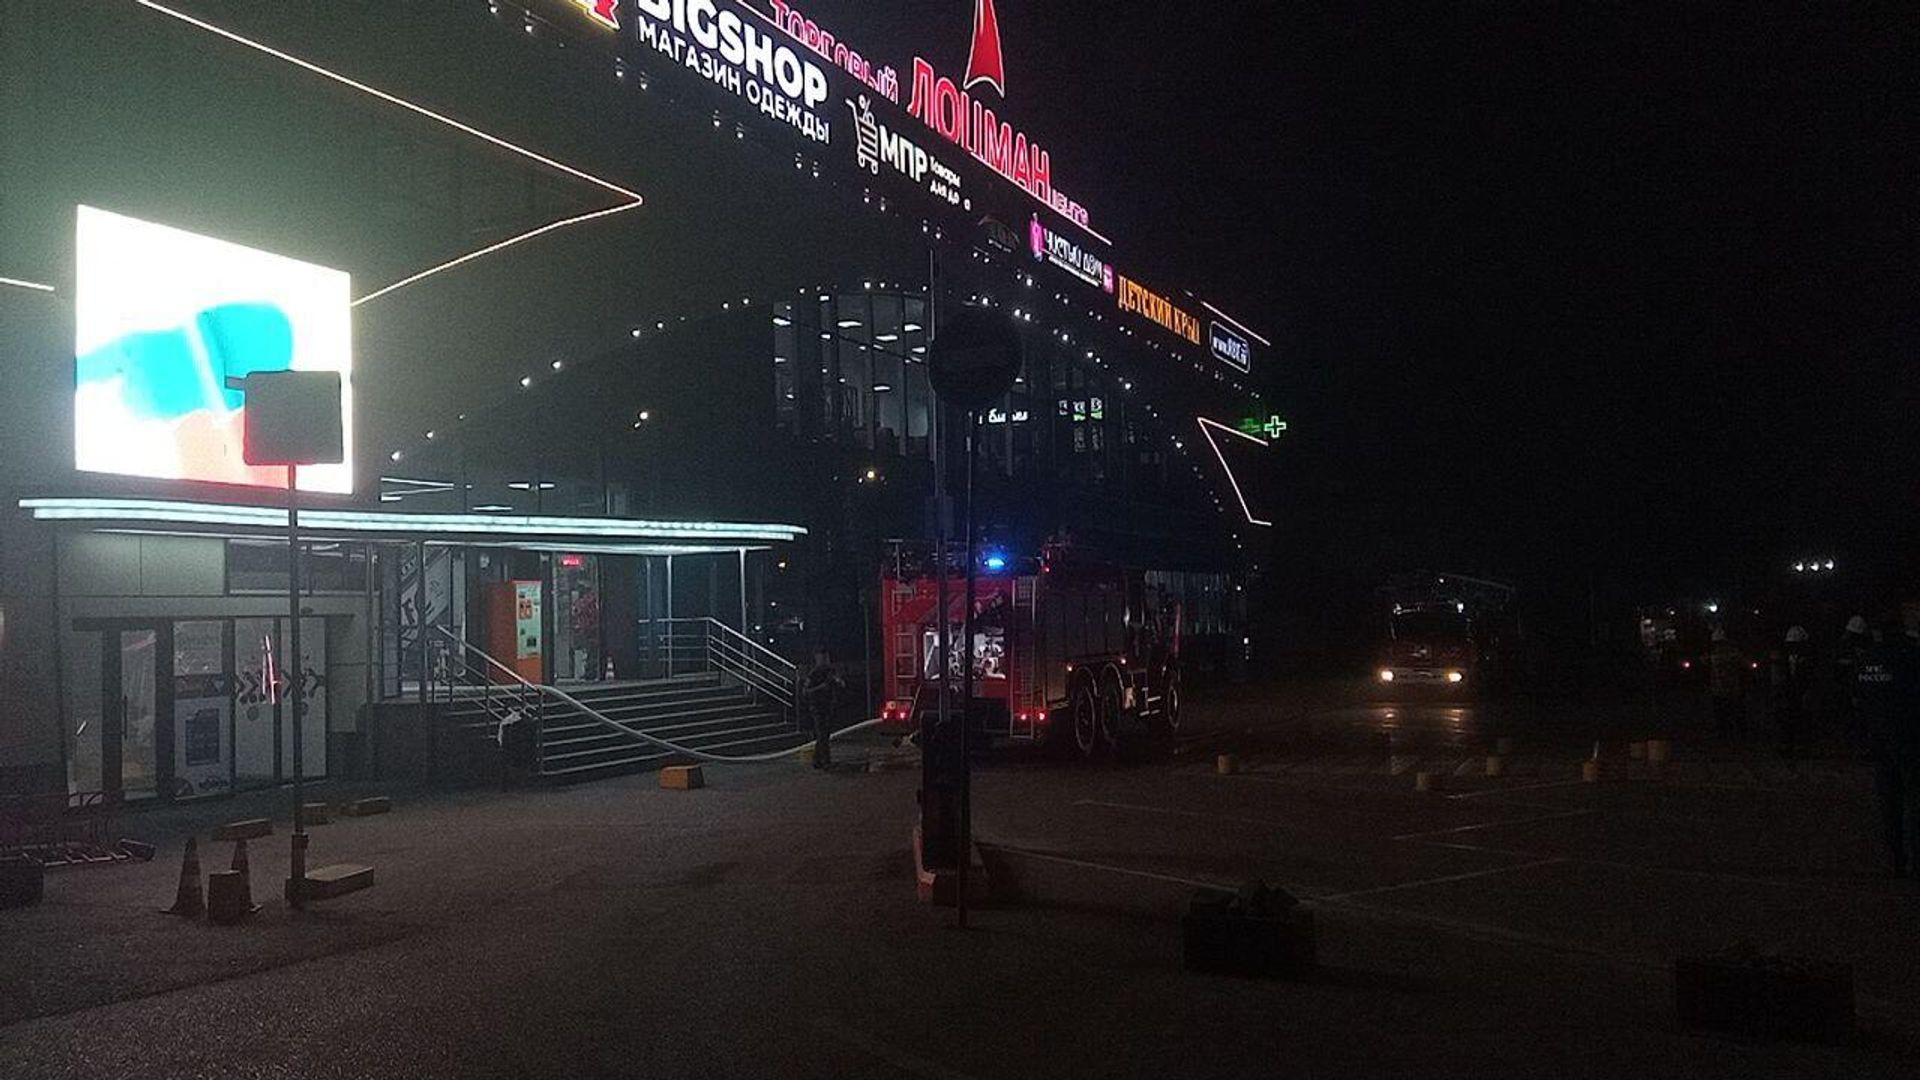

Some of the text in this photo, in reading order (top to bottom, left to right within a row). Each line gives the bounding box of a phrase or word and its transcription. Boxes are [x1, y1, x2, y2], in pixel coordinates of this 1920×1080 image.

[638, 15, 830, 144] МАГАЗИН ОДЕЖДЫ
[907, 56, 1050, 202] ЛОЦМАН
[879, 124, 928, 182] МПР
